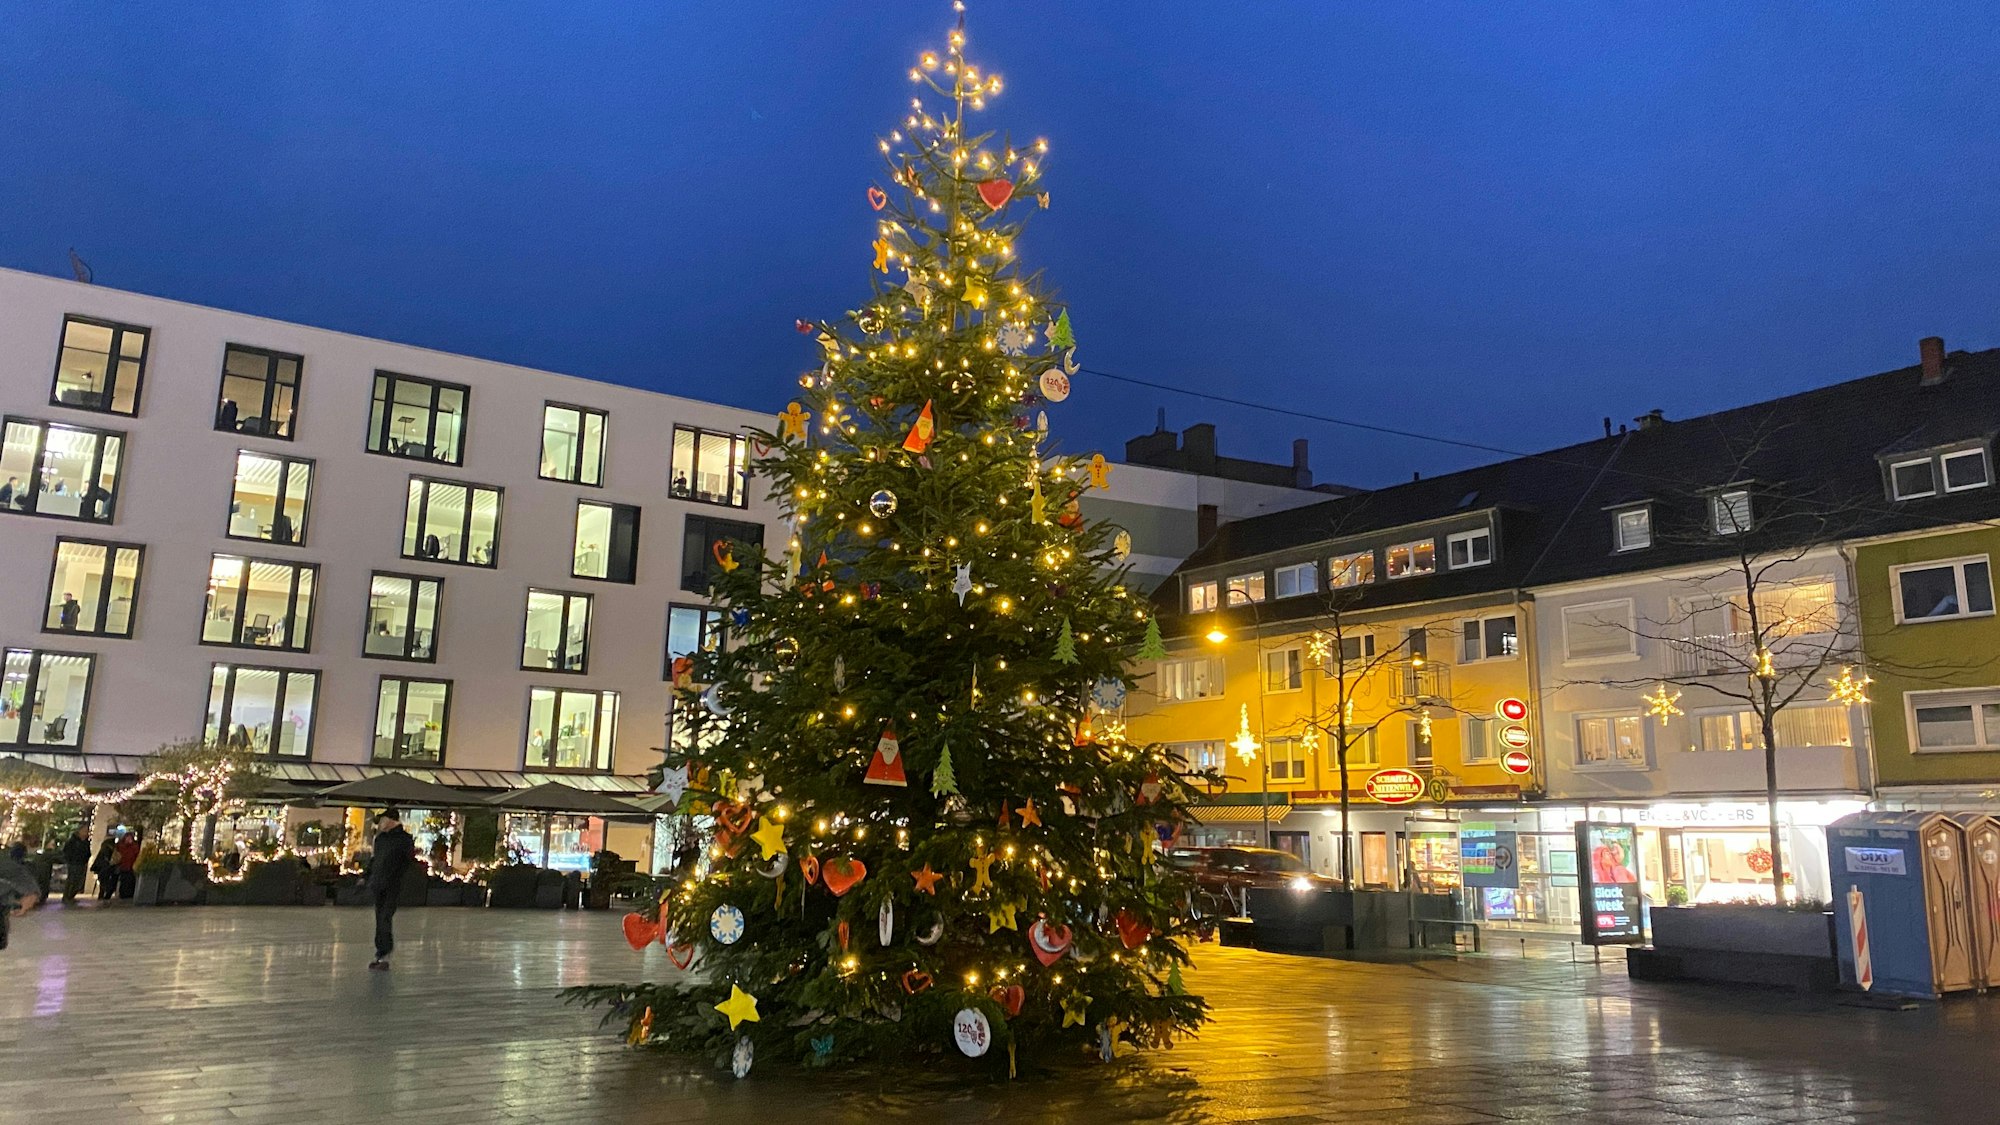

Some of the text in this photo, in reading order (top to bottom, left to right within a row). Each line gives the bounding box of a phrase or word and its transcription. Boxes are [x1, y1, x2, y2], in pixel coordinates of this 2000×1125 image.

[1861, 853, 1888, 863] DIXI
[1594, 887, 1624, 898] Black
[1595, 899, 1625, 911] Week
